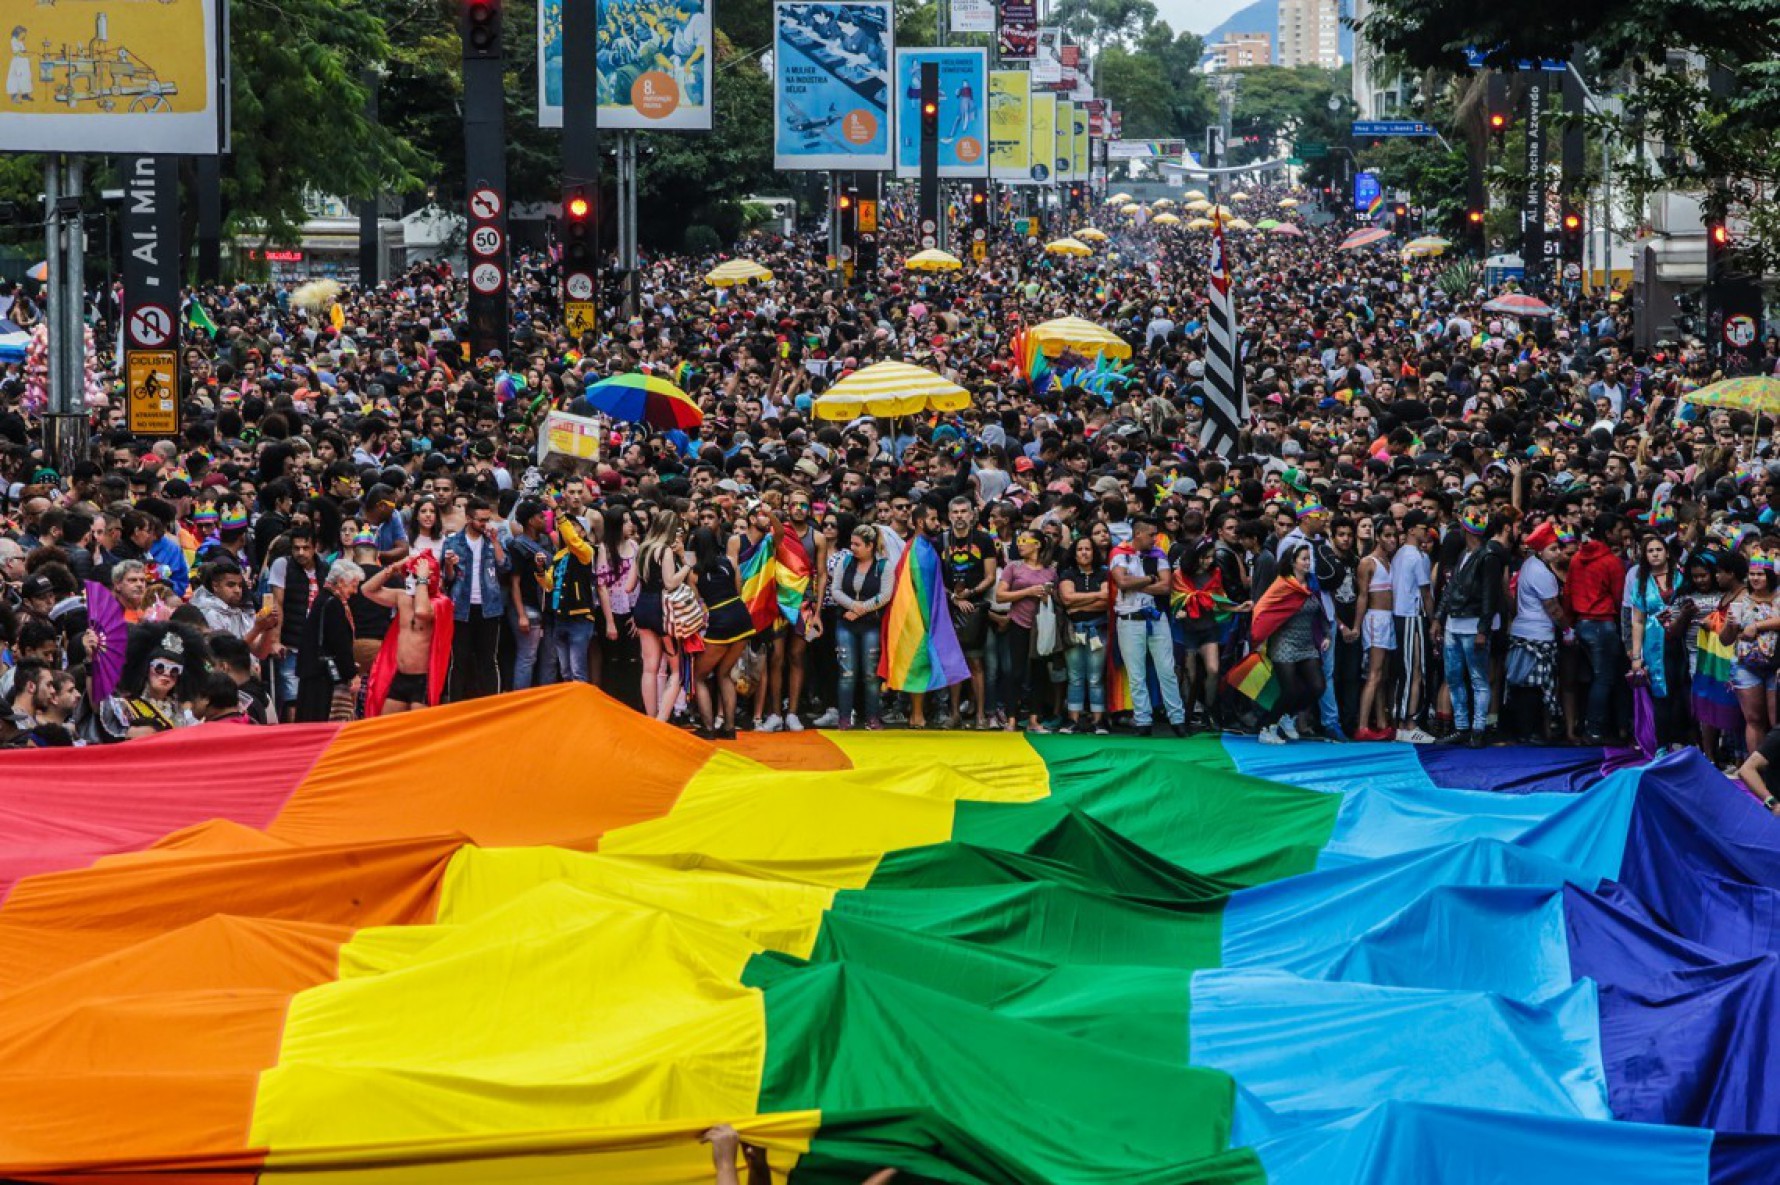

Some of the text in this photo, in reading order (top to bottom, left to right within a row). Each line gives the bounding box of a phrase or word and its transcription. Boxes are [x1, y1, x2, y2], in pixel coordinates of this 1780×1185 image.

[1528, 85, 1540, 137] Azevedo
[130, 158, 158, 265] Al. Min
[476, 232, 497, 247] 50
[130, 357, 172, 365] CICLISTA
